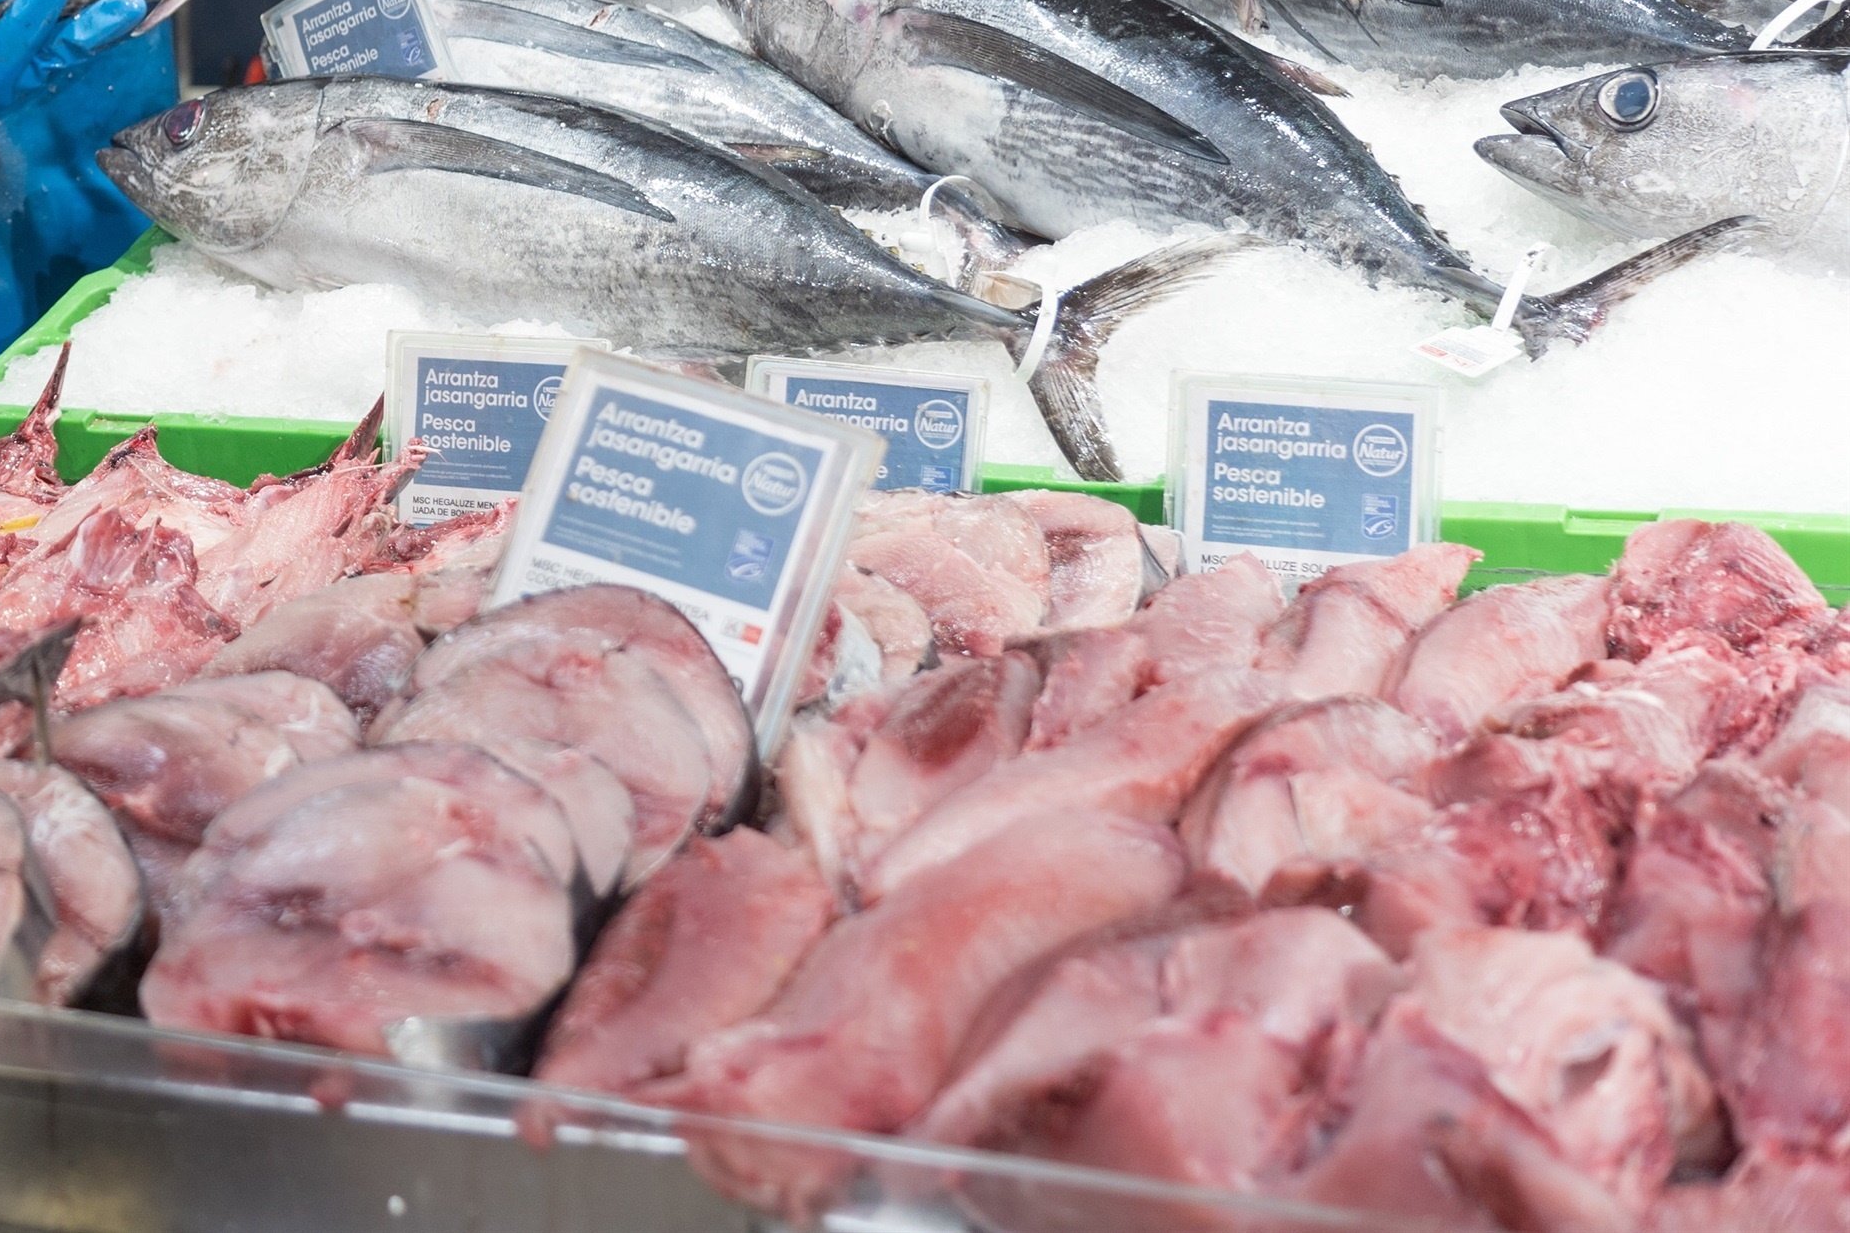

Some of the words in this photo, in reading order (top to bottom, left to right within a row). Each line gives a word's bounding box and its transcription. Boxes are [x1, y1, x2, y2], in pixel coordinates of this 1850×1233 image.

[302, 1, 352, 34] Arrantza
[305, 6, 377, 51] jasangarria
[311, 44, 349, 70] Pesca
[425, 368, 498, 388] Arrantza
[424, 386, 527, 410] jasangarria
[794, 389, 877, 411] Arrantza
[422, 413, 475, 432] Pesca
[597, 401, 705, 448] Arrantza
[919, 417, 958, 433] Natur
[1217, 412, 1310, 436] Arrantza
[421, 432, 511, 452] sostenible
[586, 422, 738, 485] jasangarria
[1215, 433, 1347, 460] jasangarria
[1358, 442, 1402, 459] Natur
[574, 455, 654, 496] Pesca
[748, 471, 798, 498] Natur
[1214, 462, 1281, 485] Pesca
[413, 496, 430, 504] MSC
[433, 498, 475, 508] HEGALUZE
[567, 481, 696, 534] sostenible
[1212, 485, 1326, 509] sostenible
[438, 508, 448, 516] DE
